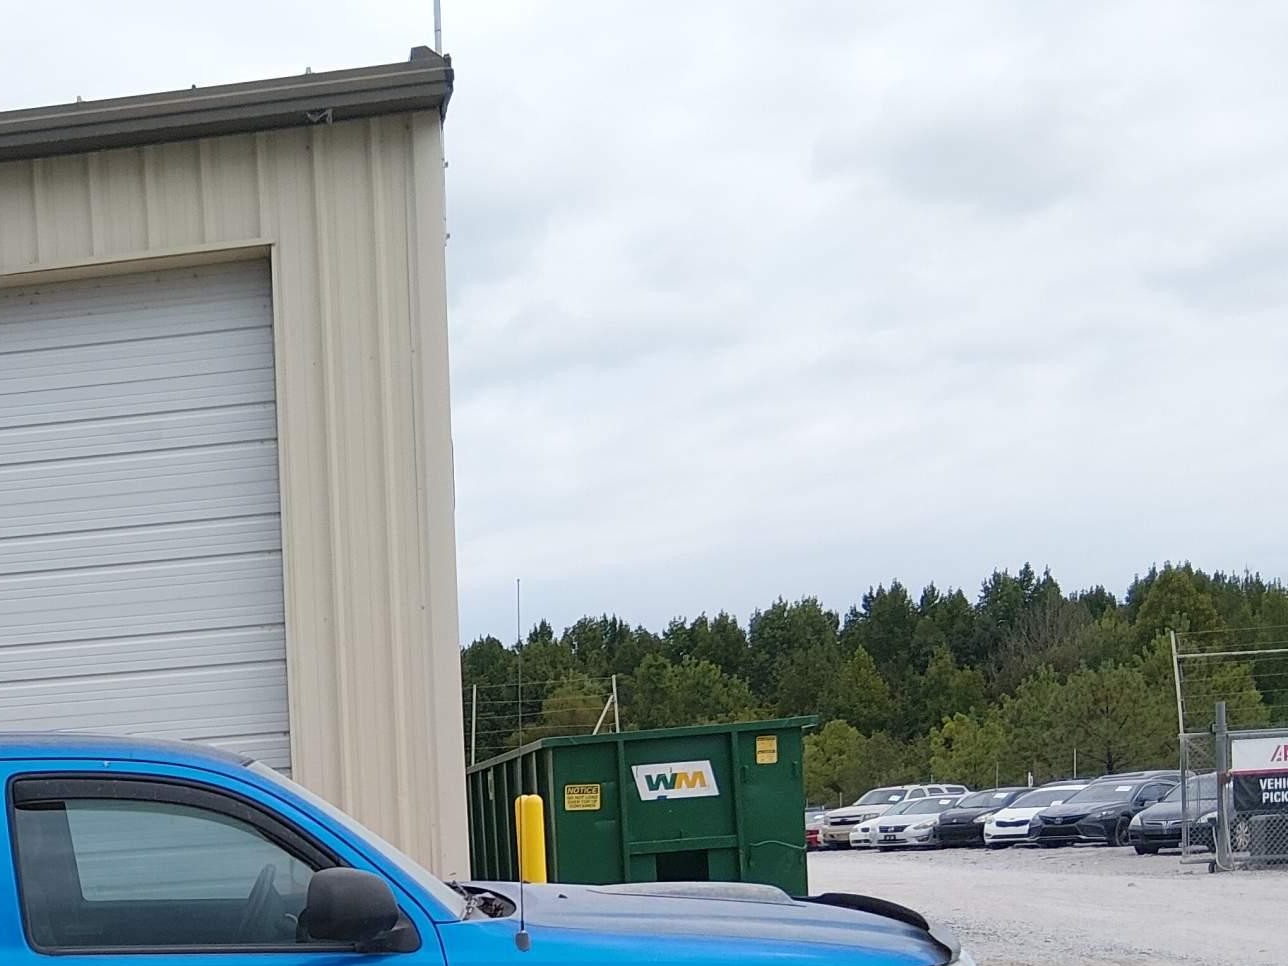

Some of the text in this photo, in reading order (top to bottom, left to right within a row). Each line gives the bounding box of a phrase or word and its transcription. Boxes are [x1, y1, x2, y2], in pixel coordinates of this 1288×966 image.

[644, 770, 707, 792] WM
[1259, 777, 1288, 790] VEHI
[568, 786, 598, 795] NOTICE
